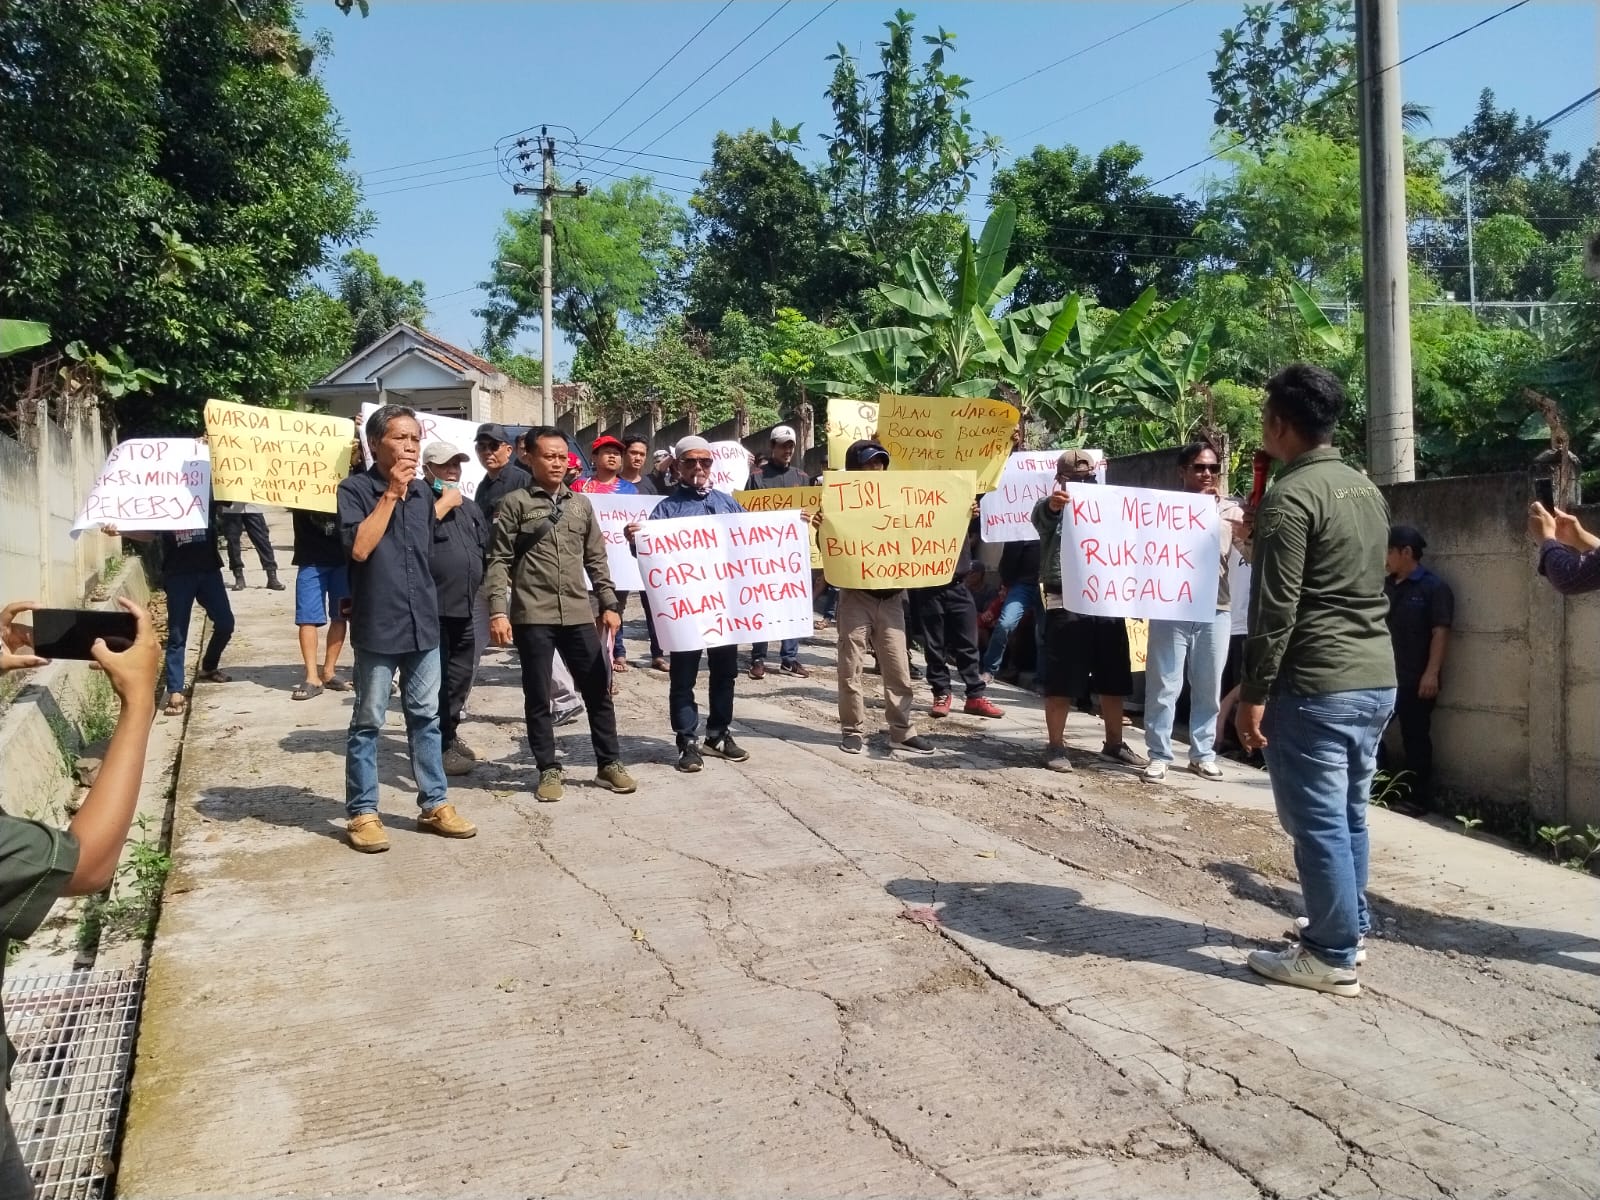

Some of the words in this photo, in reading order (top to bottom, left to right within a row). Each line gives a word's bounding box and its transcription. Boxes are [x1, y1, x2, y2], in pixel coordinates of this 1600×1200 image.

[881, 397, 931, 420] JALAN
[951, 403, 1011, 418] WARGA
[279, 415, 345, 437] LOKAL
[888, 423, 944, 440] BOLONG
[958, 425, 1007, 441] BOLONG
[107, 441, 169, 467] STOP
[207, 433, 243, 450] TAK
[250, 436, 325, 458] PANTAS
[711, 446, 746, 460] NGAN
[955, 450, 973, 462] KU
[210, 452, 253, 473] JADI
[266, 458, 328, 479] STAP
[253, 477, 306, 493] PANTAS
[829, 480, 891, 512] TJSL
[900, 486, 948, 506] TIDAK
[86, 494, 206, 521] PEKERJA
[600, 508, 649, 523] HANYA
[1072, 497, 1102, 526] KU
[1121, 496, 1206, 530] MEMEK
[872, 510, 934, 530] JELAS
[601, 531, 627, 544] RE
[638, 527, 718, 556] JANGAN
[728, 522, 799, 549] HANYA
[826, 537, 900, 557] BUKAN
[911, 536, 957, 556] DANA
[1080, 538, 1195, 570] RUKSAK
[648, 562, 707, 590] CARI
[715, 550, 802, 582] UNTUNG
[861, 557, 956, 580] KOORDINASI
[1082, 574, 1193, 604] SAGALA
[656, 591, 727, 623] JALAN
[739, 580, 808, 605] OMEAN
